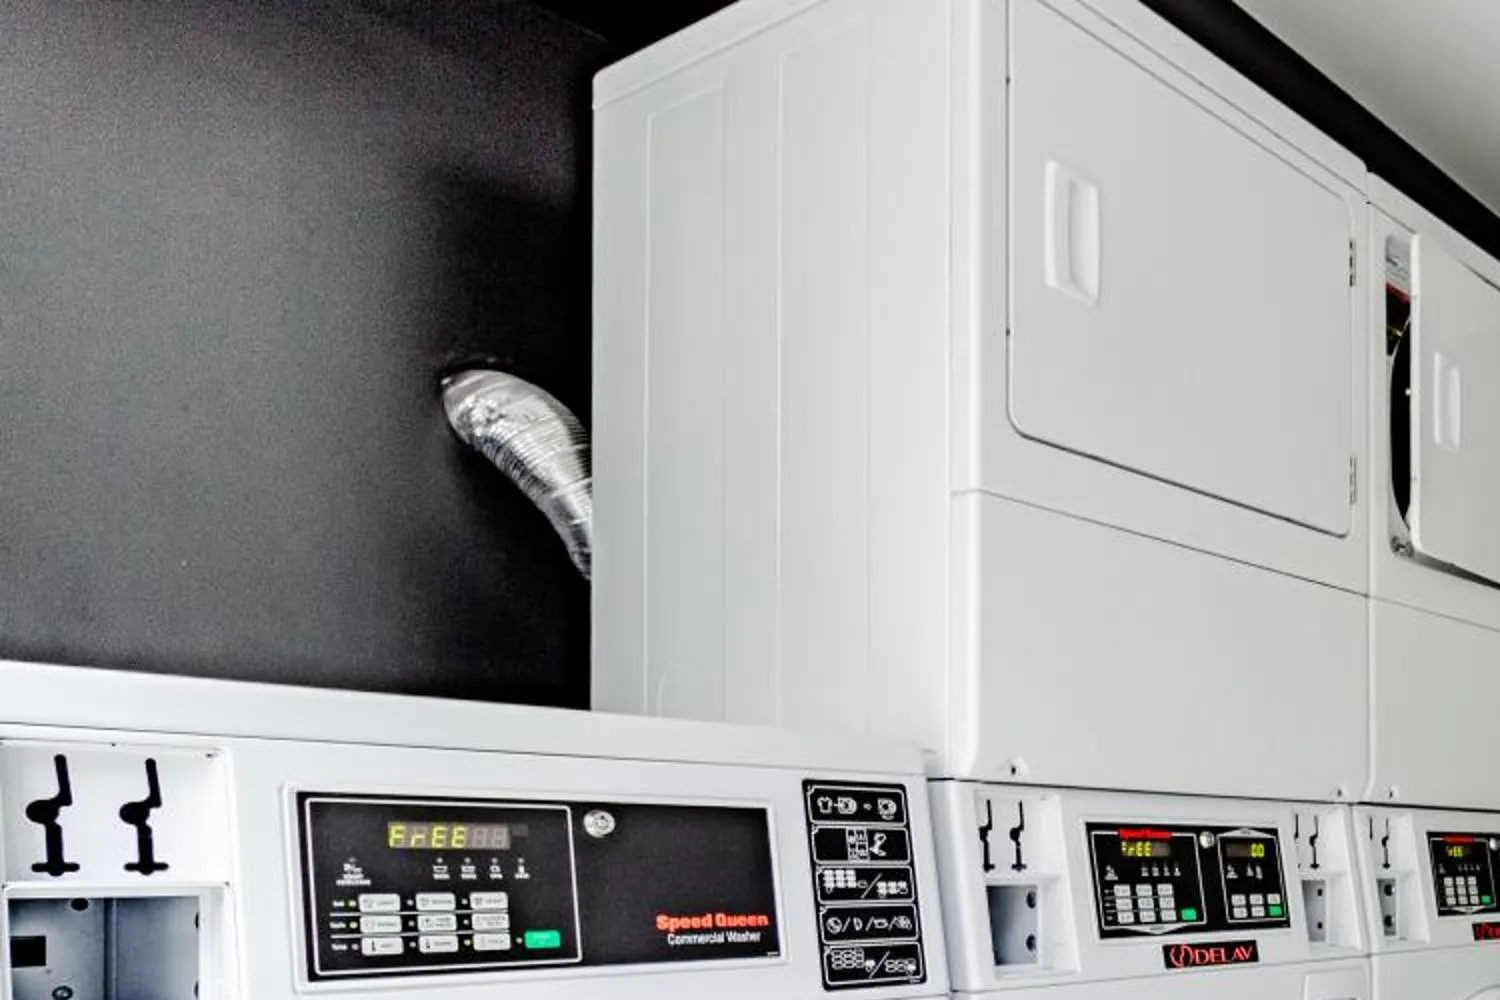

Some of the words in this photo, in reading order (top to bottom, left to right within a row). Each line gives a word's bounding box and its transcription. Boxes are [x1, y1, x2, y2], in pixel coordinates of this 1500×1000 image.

[656, 913, 713, 933] Speed
[715, 912, 769, 928] Queen
[667, 931, 725, 945] Commercial
[726, 930, 761, 943] Washer
